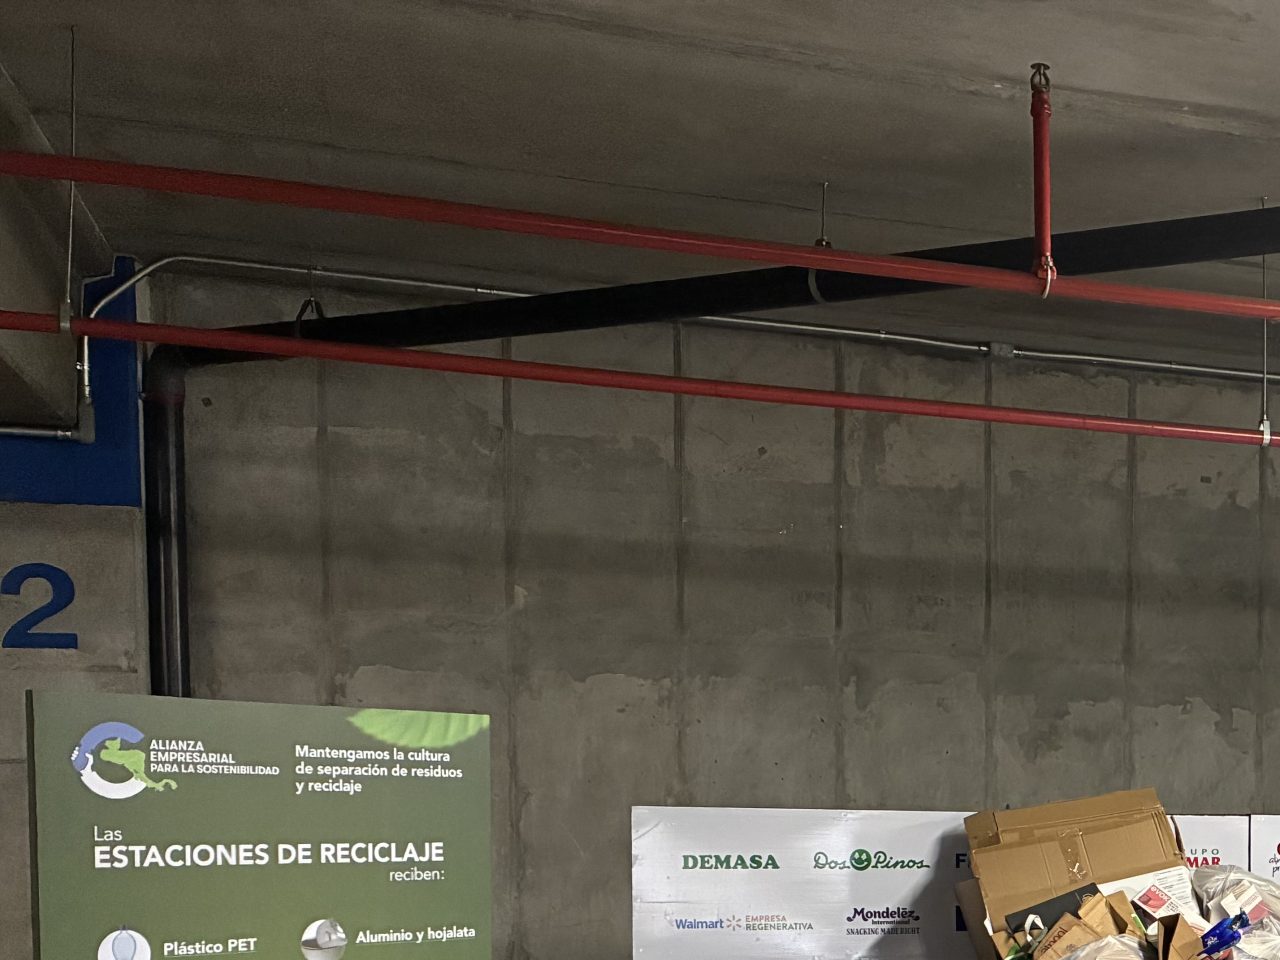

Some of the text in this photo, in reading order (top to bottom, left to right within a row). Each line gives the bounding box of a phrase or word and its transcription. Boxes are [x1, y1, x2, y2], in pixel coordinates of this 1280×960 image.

[1, 563, 78, 649] 2
[150, 739, 204, 751] ALIANZA
[150, 751, 236, 764] EMPRESARIAL
[295, 745, 450, 762] Mantengamos la cultura
[150, 763, 280, 775] PARA LA SOSTENIBILIDAD
[295, 761, 463, 778] de separación de residuos
[295, 780, 362, 795] y reciclaje
[94, 826, 122, 841] Las
[94, 842, 444, 869] ESTACIONES DE RECICLAJE
[1189, 848, 1220, 856] UPO
[682, 854, 780, 870] DEMASA
[814, 850, 931, 870] Dos Pinos
[389, 869, 445, 882] reciben:
[675, 918, 724, 929] Walmart
[745, 923, 814, 931] REGENERATIVA
[356, 926, 476, 945] Aluminio y hojalata
[163, 938, 257, 957] Plástico PET
